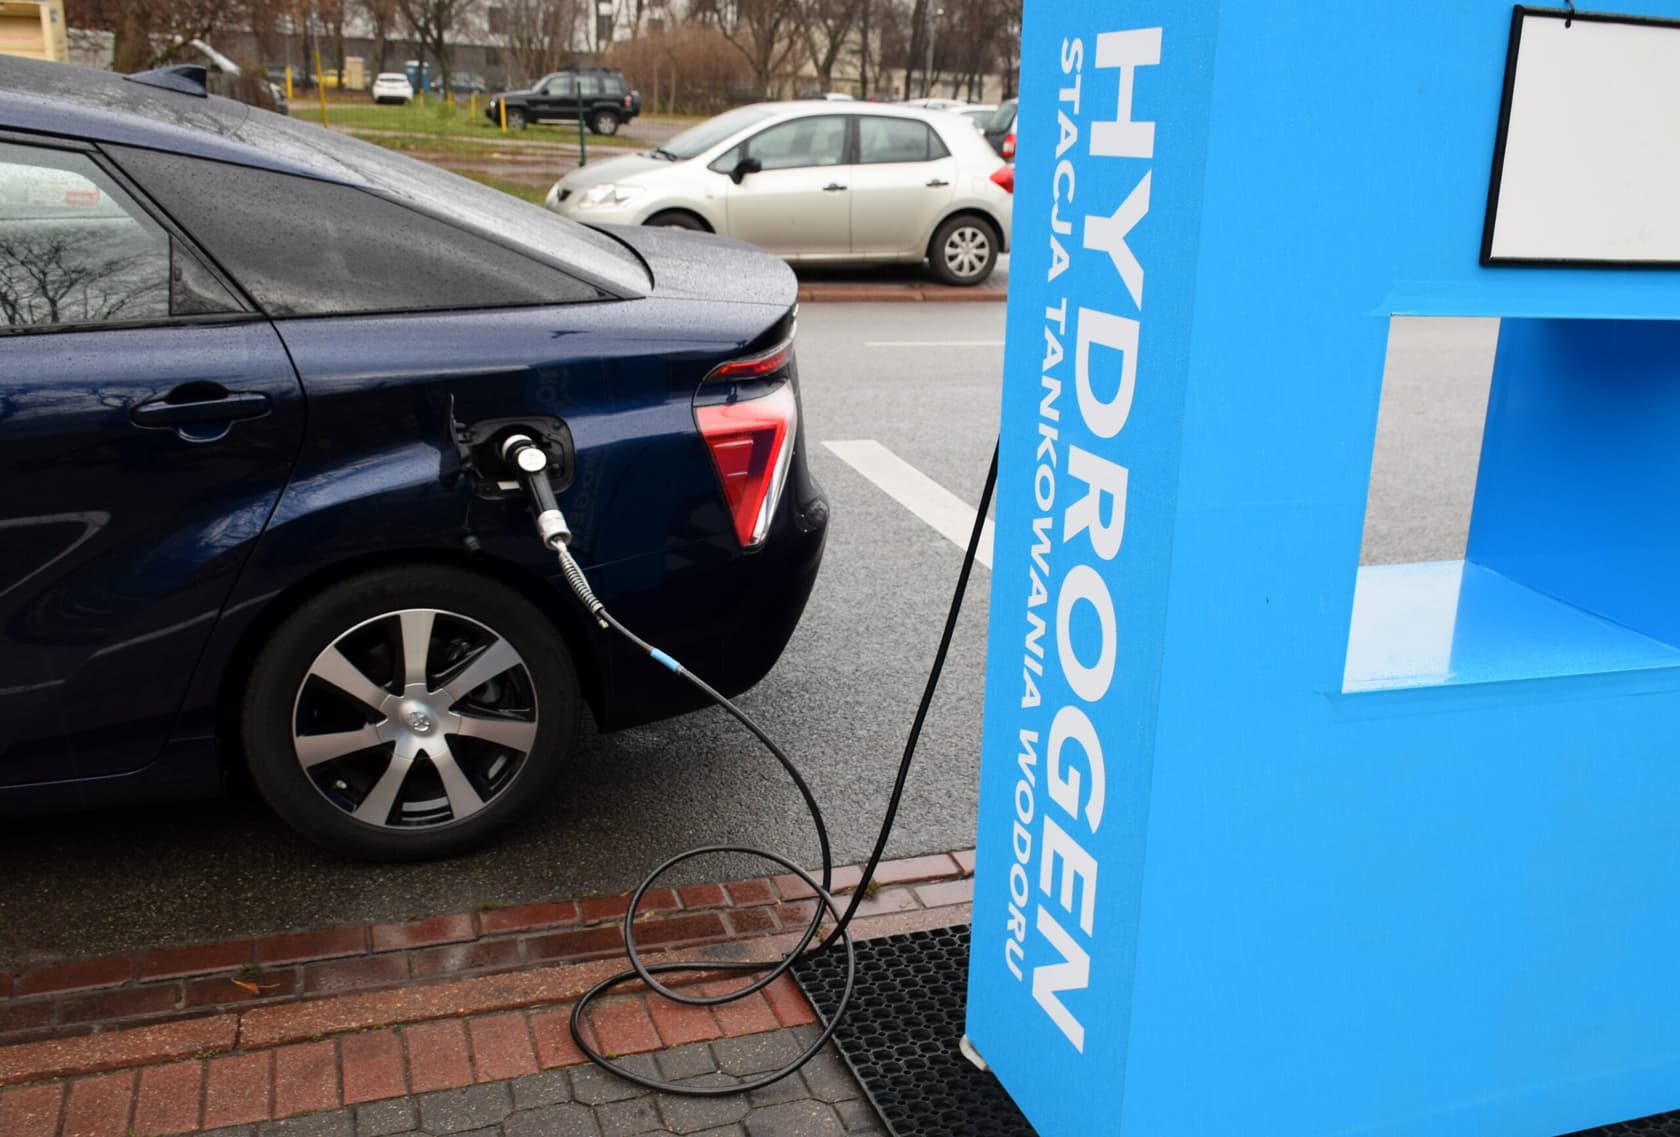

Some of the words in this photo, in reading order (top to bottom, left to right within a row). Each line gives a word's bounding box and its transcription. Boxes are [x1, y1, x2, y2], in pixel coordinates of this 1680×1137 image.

[1048, 38, 1084, 281] STACJA
[1021, 297, 1067, 708] TANKOWANIA
[1032, 26, 1163, 1053] HYDROGEN
[1005, 729, 1039, 981] WODORU
